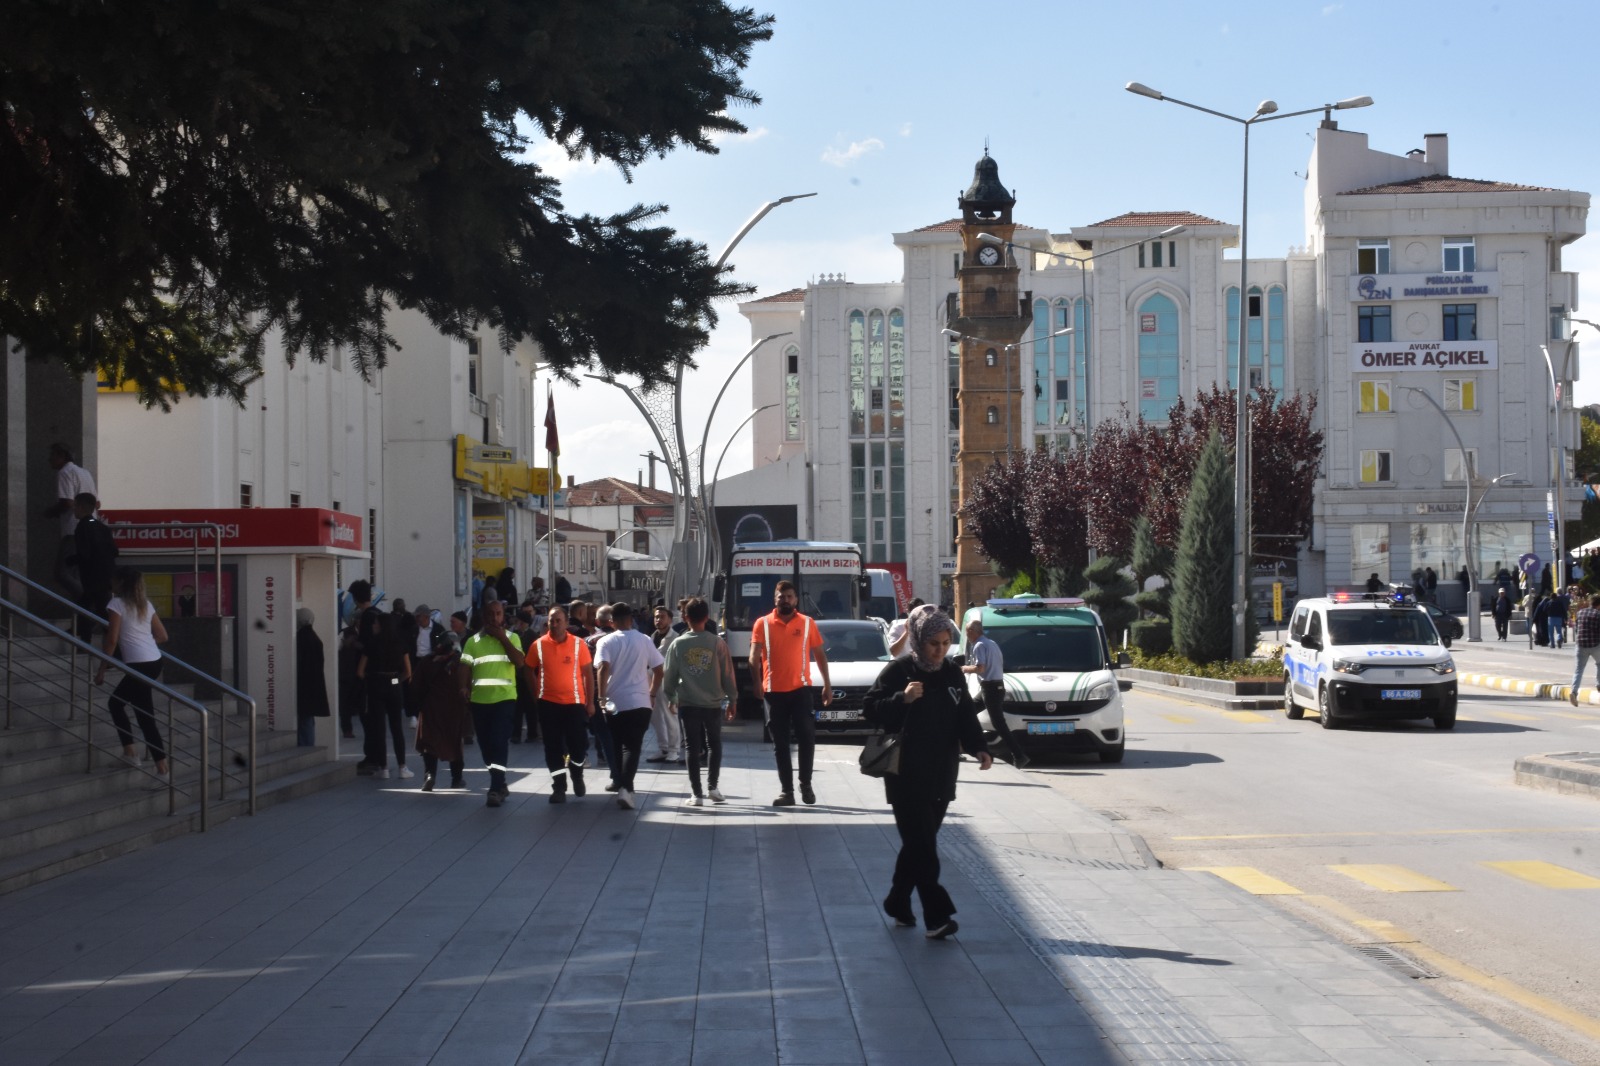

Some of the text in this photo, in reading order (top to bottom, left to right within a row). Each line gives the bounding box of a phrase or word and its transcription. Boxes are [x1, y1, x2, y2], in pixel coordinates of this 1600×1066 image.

[1426, 275, 1473, 285] PSİKOLOJİK
[1404, 287, 1459, 297] DANIŞMANLIK
[1361, 350, 1489, 368] ÖMER AÇIKEL
[800, 559, 831, 567] TAKIM
[942, 560, 958, 569] mi
[266, 603, 274, 621] 444
[1366, 649, 1425, 657] POLİS
